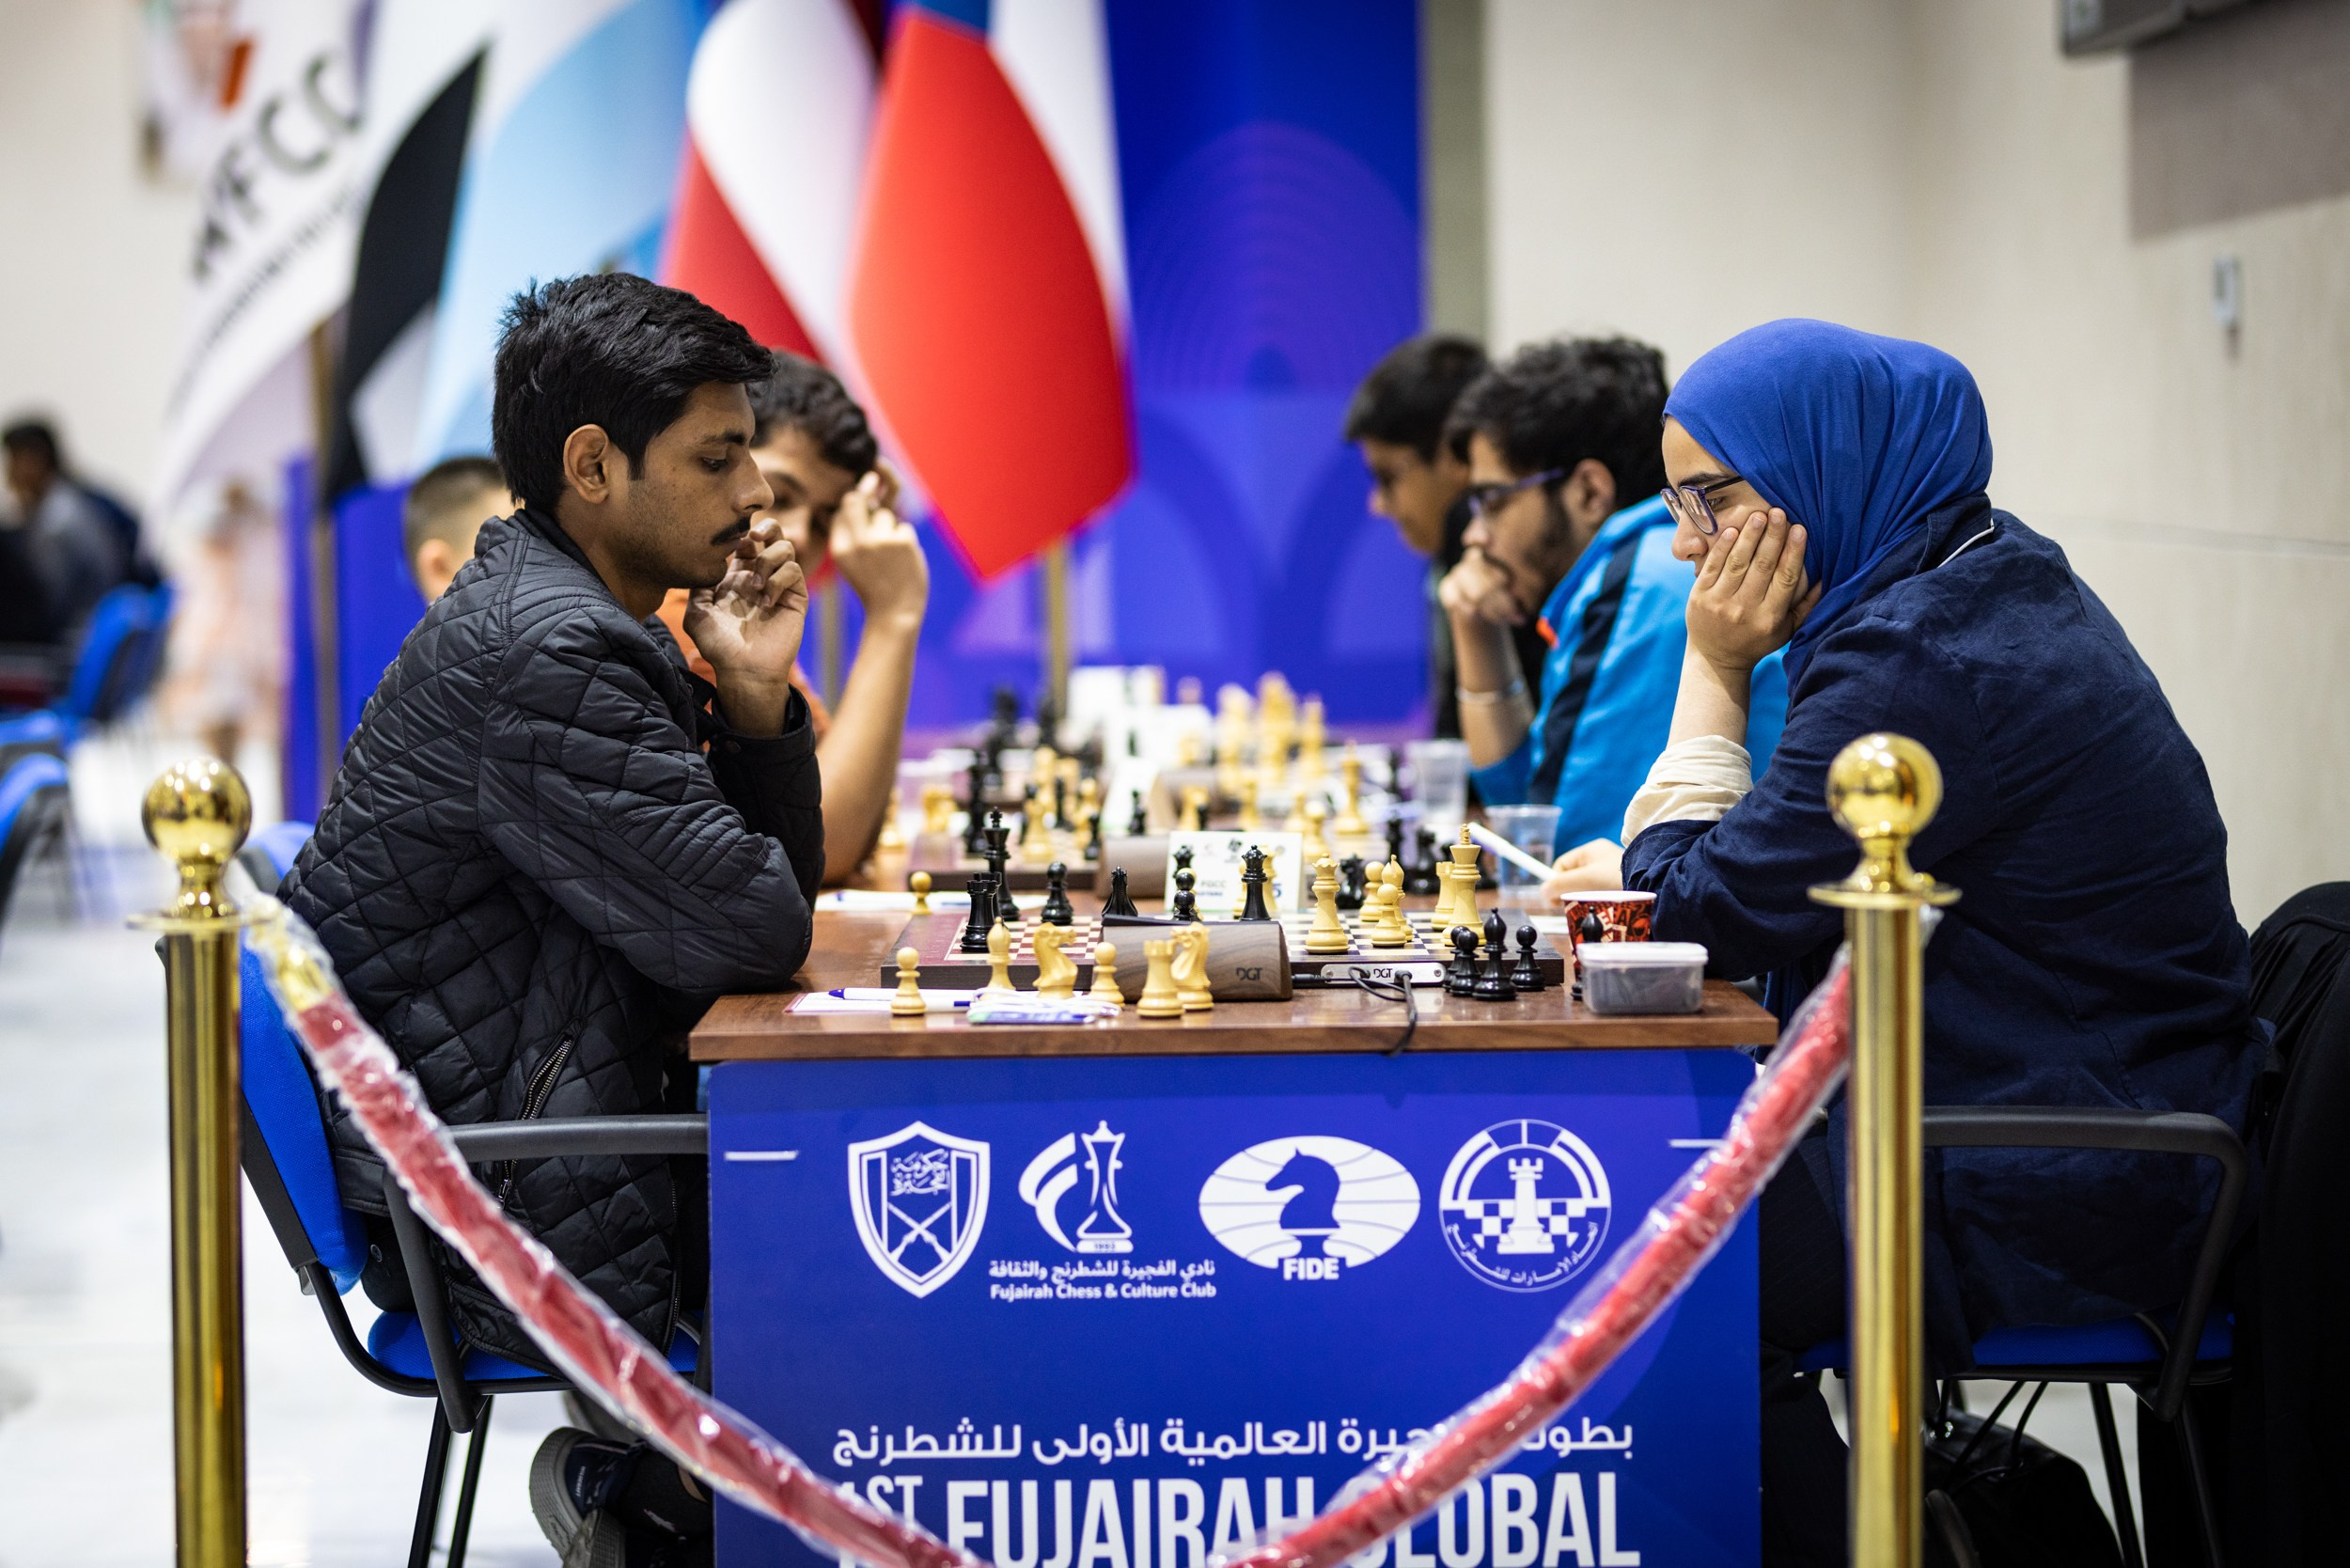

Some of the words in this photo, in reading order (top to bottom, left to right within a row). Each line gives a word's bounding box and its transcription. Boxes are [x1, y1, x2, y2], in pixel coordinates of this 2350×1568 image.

[1235, 966, 1263, 981] DGT
[1372, 967, 1393, 979] DGT
[989, 1260, 1048, 1280] والثقافة
[1051, 1260, 1119, 1285] للشطرنج
[1121, 1260, 1177, 1280] الفجيرة
[1179, 1259, 1215, 1283] نادي
[1283, 1257, 1340, 1280] FIDE
[990, 1283, 1054, 1303] Fujairah
[1056, 1283, 1103, 1299] Chess
[1104, 1283, 1119, 1298] &
[1120, 1282, 1179, 1299] Culture
[1181, 1281, 1217, 1298] Club
[833, 1417, 1022, 1466] للشطرنج
[1032, 1416, 1150, 1466] الأولى
[1160, 1418, 1326, 1466] العالمية
[1515, 1416, 1634, 1460] بطول
